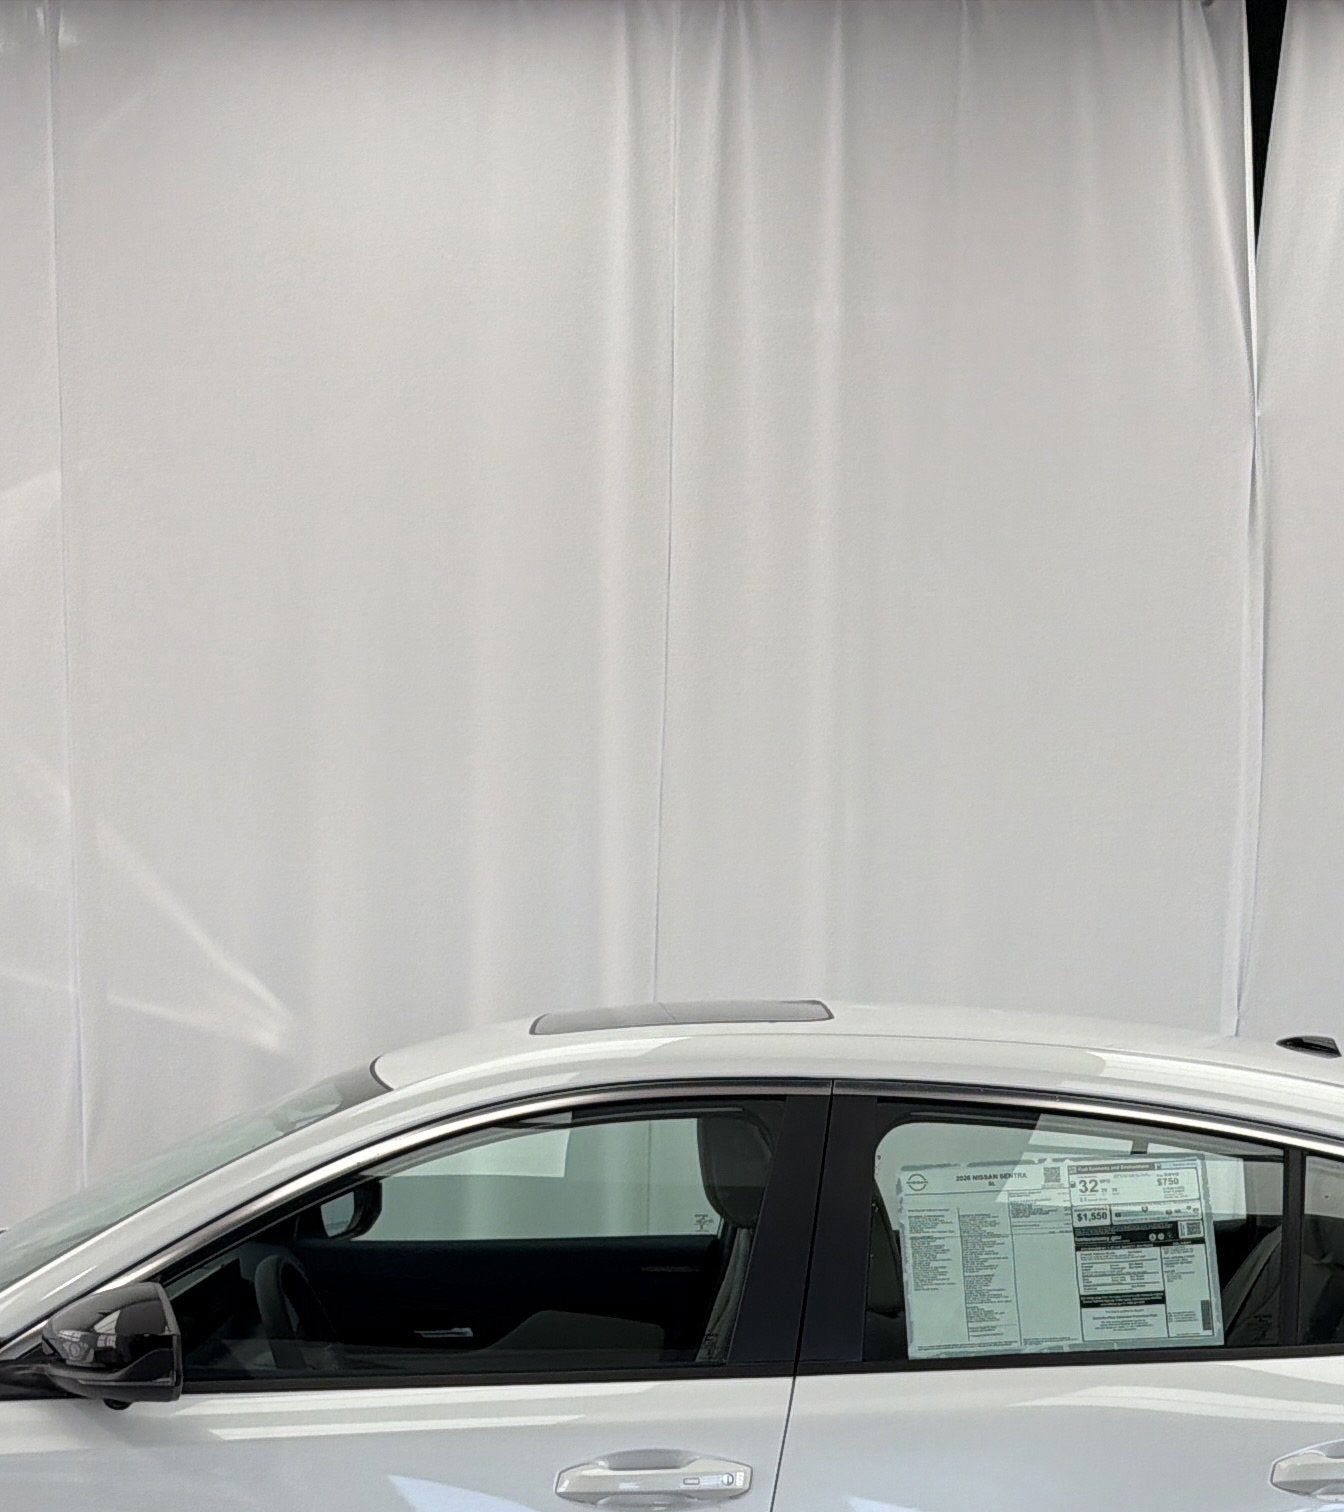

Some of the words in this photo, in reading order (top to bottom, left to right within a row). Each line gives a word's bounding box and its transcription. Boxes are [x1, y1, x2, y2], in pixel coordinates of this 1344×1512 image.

[1000, 1172, 1028, 1180] SENTRA
[1079, 1179, 1099, 1193] 32
[1157, 1177, 1179, 1186] $750
[1077, 1212, 1107, 1222] $1,550
